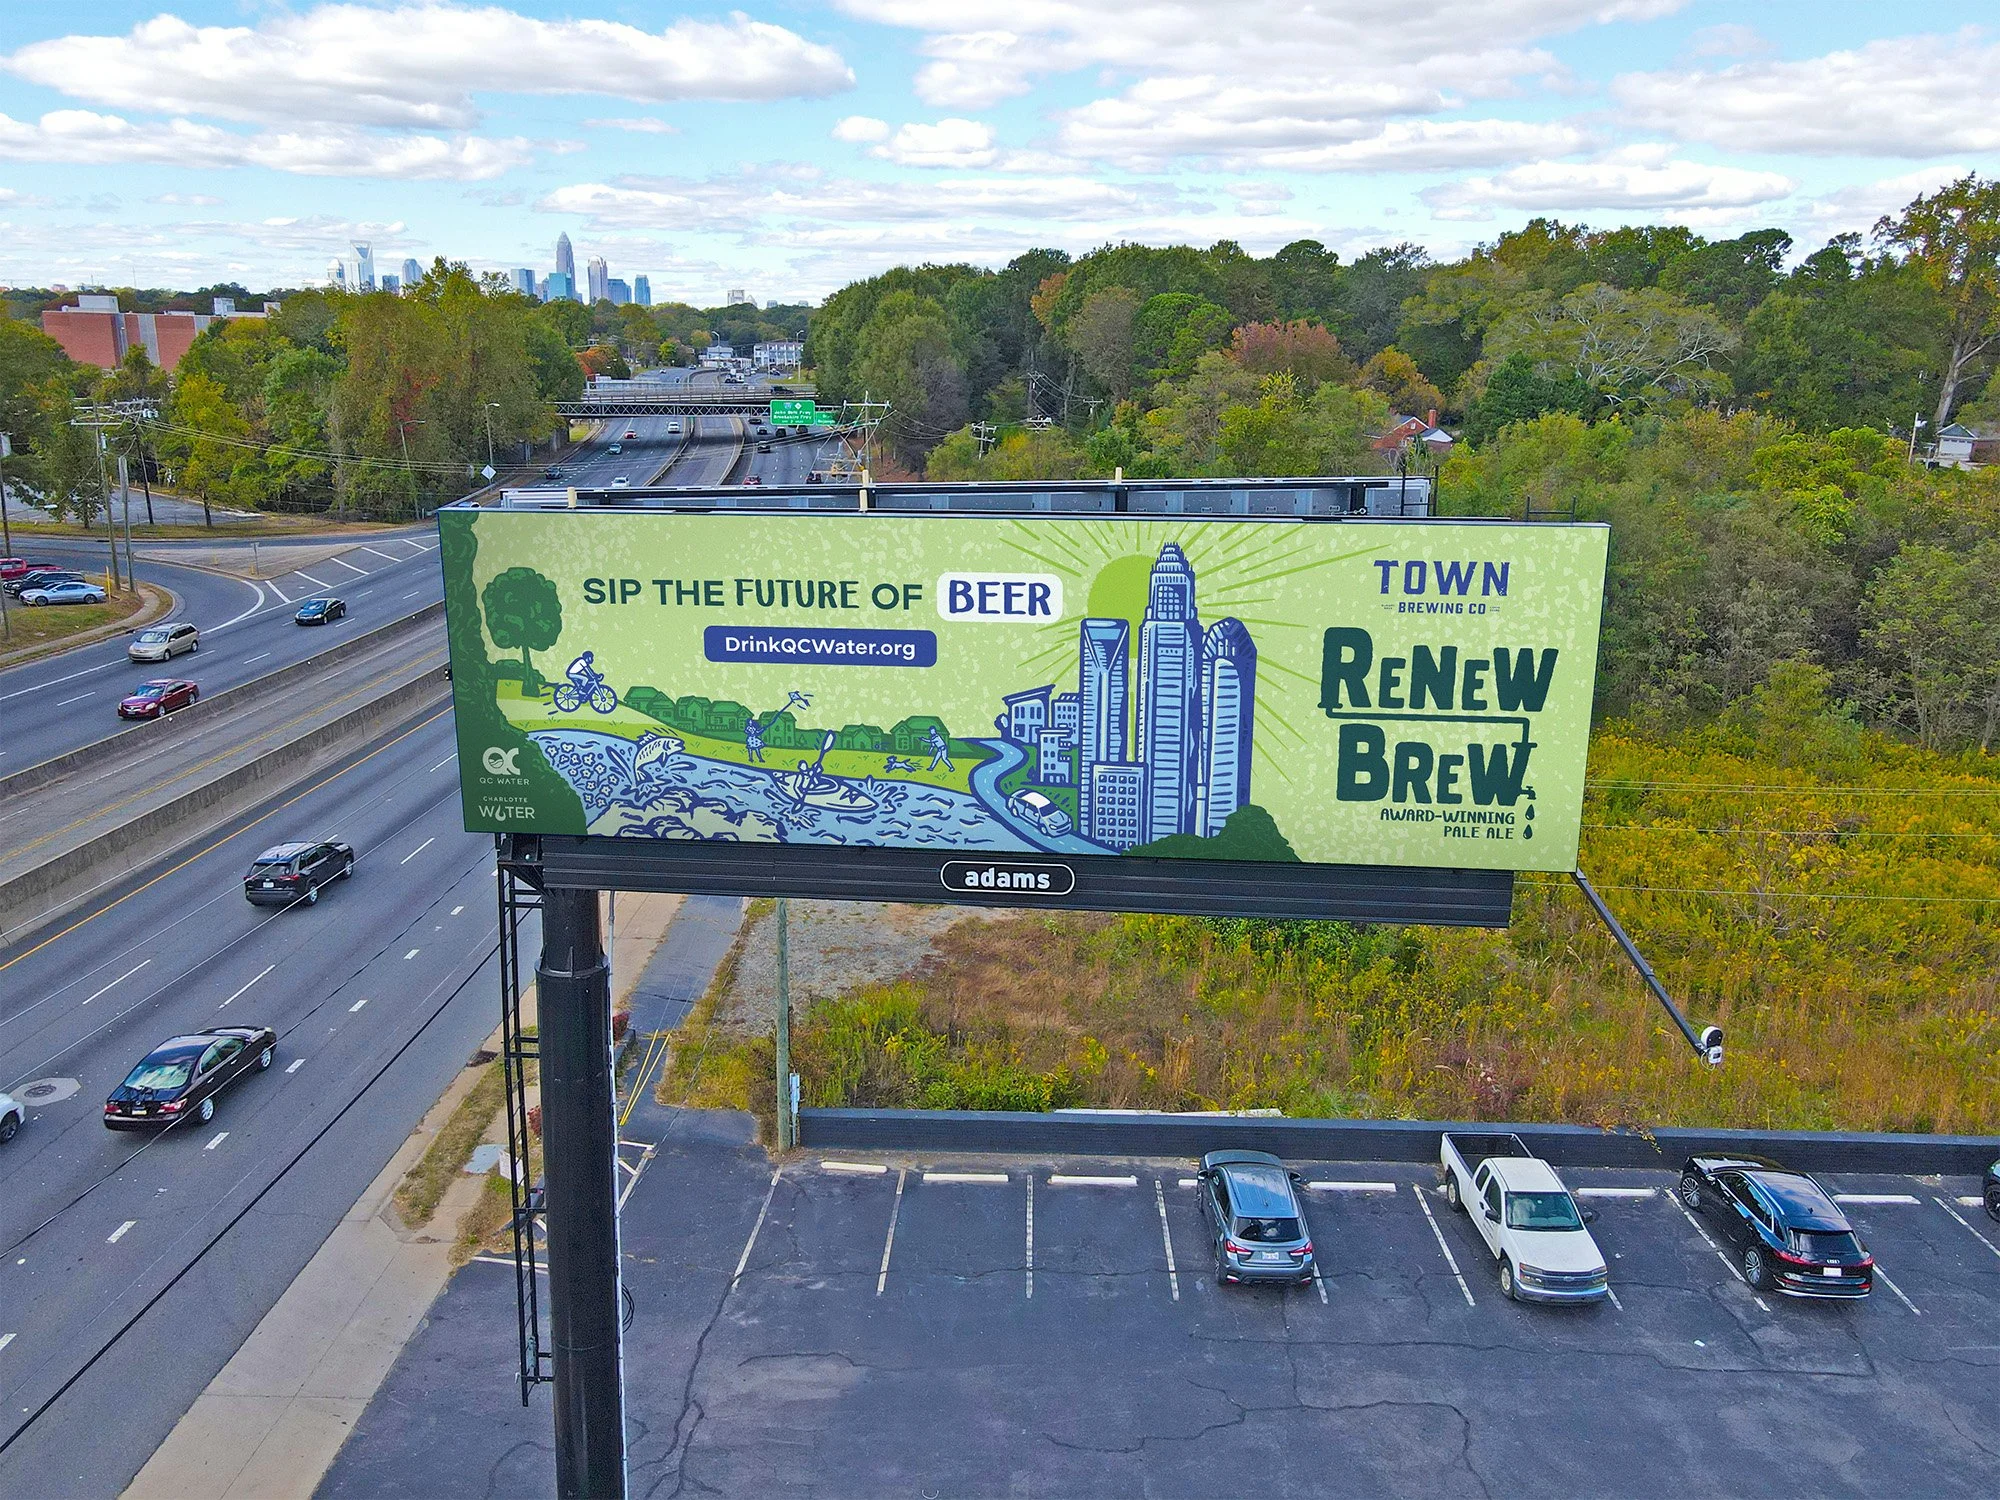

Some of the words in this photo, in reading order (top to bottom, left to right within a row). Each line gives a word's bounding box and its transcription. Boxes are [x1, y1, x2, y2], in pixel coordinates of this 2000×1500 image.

[1373, 559, 1511, 597] TOWN
[583, 577, 642, 605] SIP
[652, 579, 725, 607] THE
[734, 578, 860, 609] FUTURE
[871, 583, 923, 610] OF
[949, 579, 1052, 616] BEER
[1398, 601, 1463, 614] BREWING
[1468, 603, 1486, 615] CO
[725, 635, 916, 661] DrinkQCWater.org
[479, 777, 494, 785] QC
[497, 778, 530, 786] WATER
[1380, 808, 1515, 825] AWARD-WINNING
[1443, 825, 1480, 838] PALE
[1486, 827, 1514, 839] ALE
[964, 866, 1051, 889] adams
